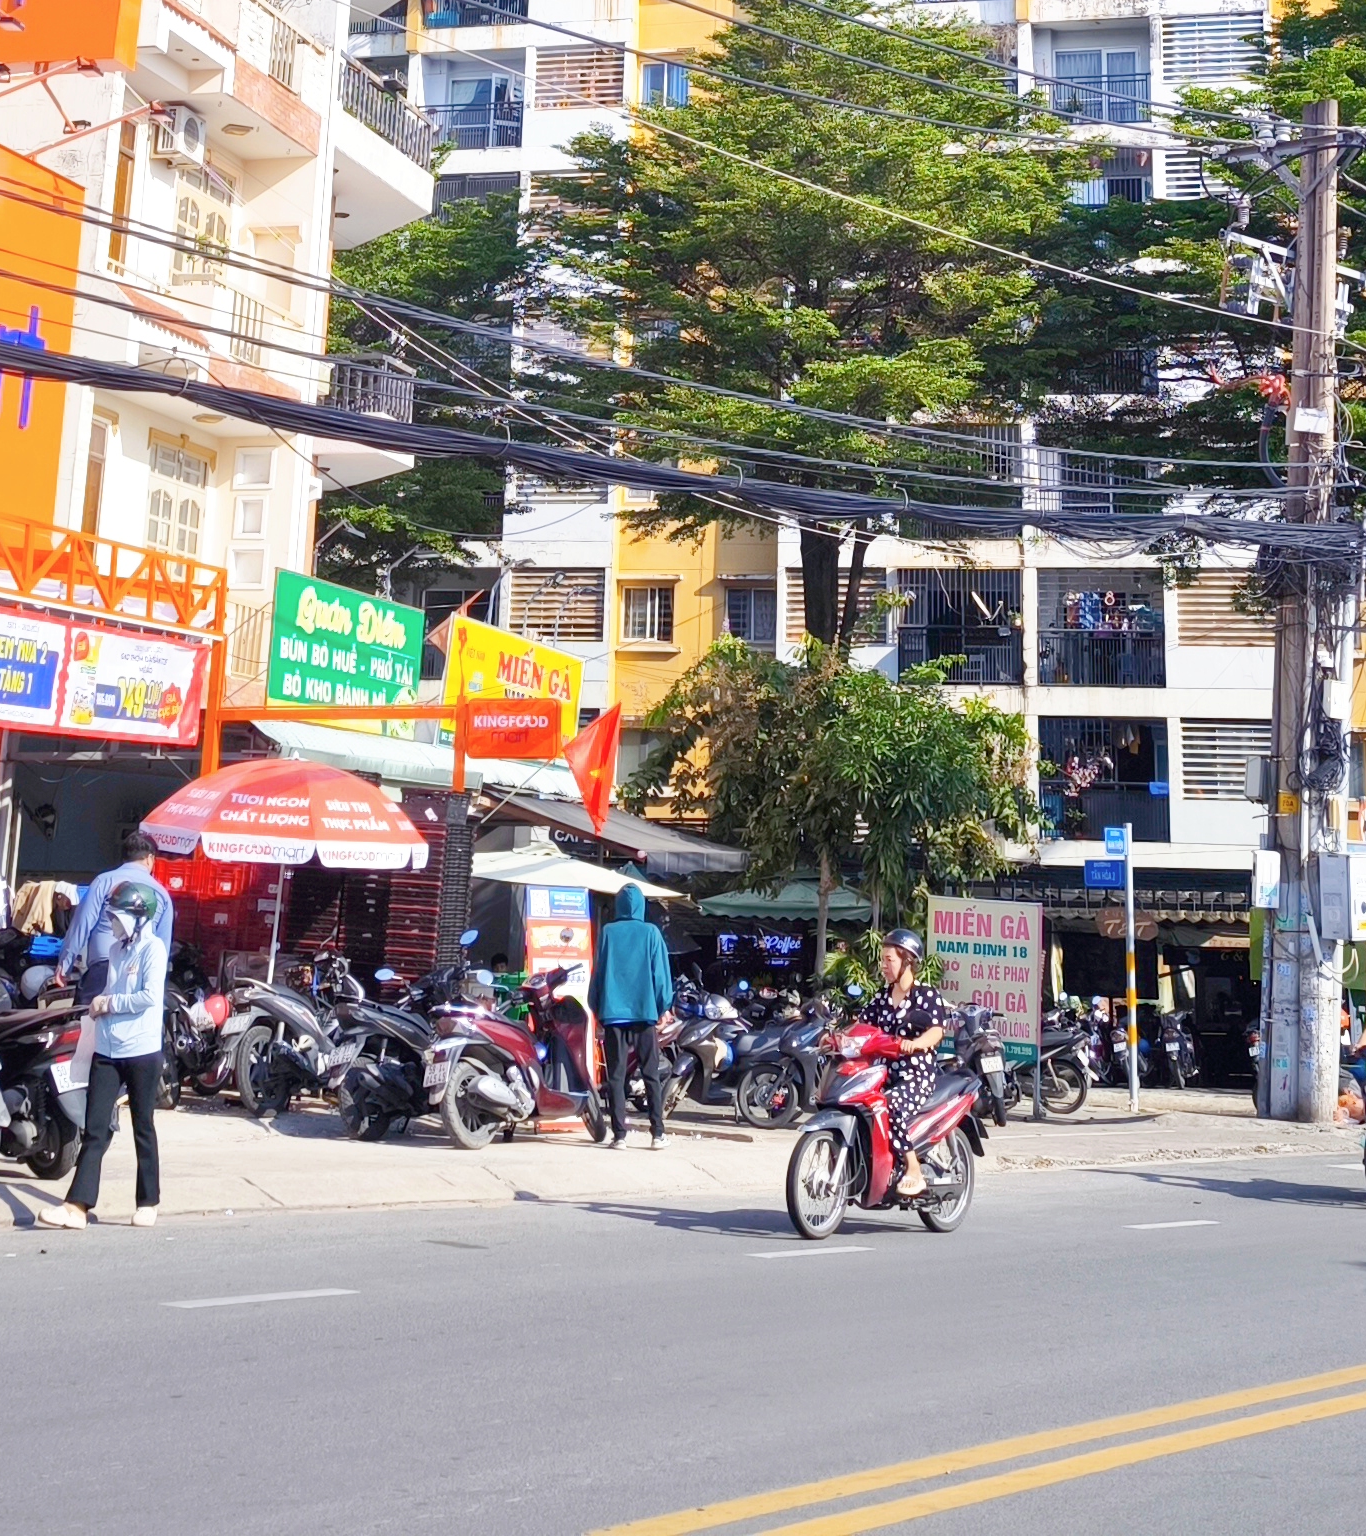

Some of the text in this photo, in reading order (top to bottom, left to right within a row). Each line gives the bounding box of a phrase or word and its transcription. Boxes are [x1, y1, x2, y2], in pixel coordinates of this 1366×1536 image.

[296, 586, 353, 636] Quán
[16, 638, 38, 663] MUA
[40, 641, 49, 665] 2
[280, 633, 308, 663] BÚN
[311, 639, 328, 668] BÒ
[332, 643, 358, 675] HUẾ
[370, 652, 393, 681] PHỞ
[394, 659, 414, 686] TÁI
[26, 672, 33, 694] 1
[496, 648, 544, 691] MIẾN
[548, 665, 571, 700] GÀ
[283, 668, 386, 706] BÒ KHO BÁNH MÌ
[474, 714, 549, 728] KINGFOOD
[491, 728, 529, 743] mart
[231, 793, 310, 809] TƯƠI NGON
[220, 809, 310, 827] CHẤT LƯỢNG
[934, 905, 1030, 941] MIẾN GÀ
[936, 940, 968, 954] NAM
[1013, 946, 1027, 958] 18
[971, 961, 984, 979] GÀ
[987, 962, 1000, 981] XÉ
[1004, 967, 1030, 983] PHAY
[972, 984, 999, 1011] GỎI
[1005, 989, 1027, 1013] GÀ
